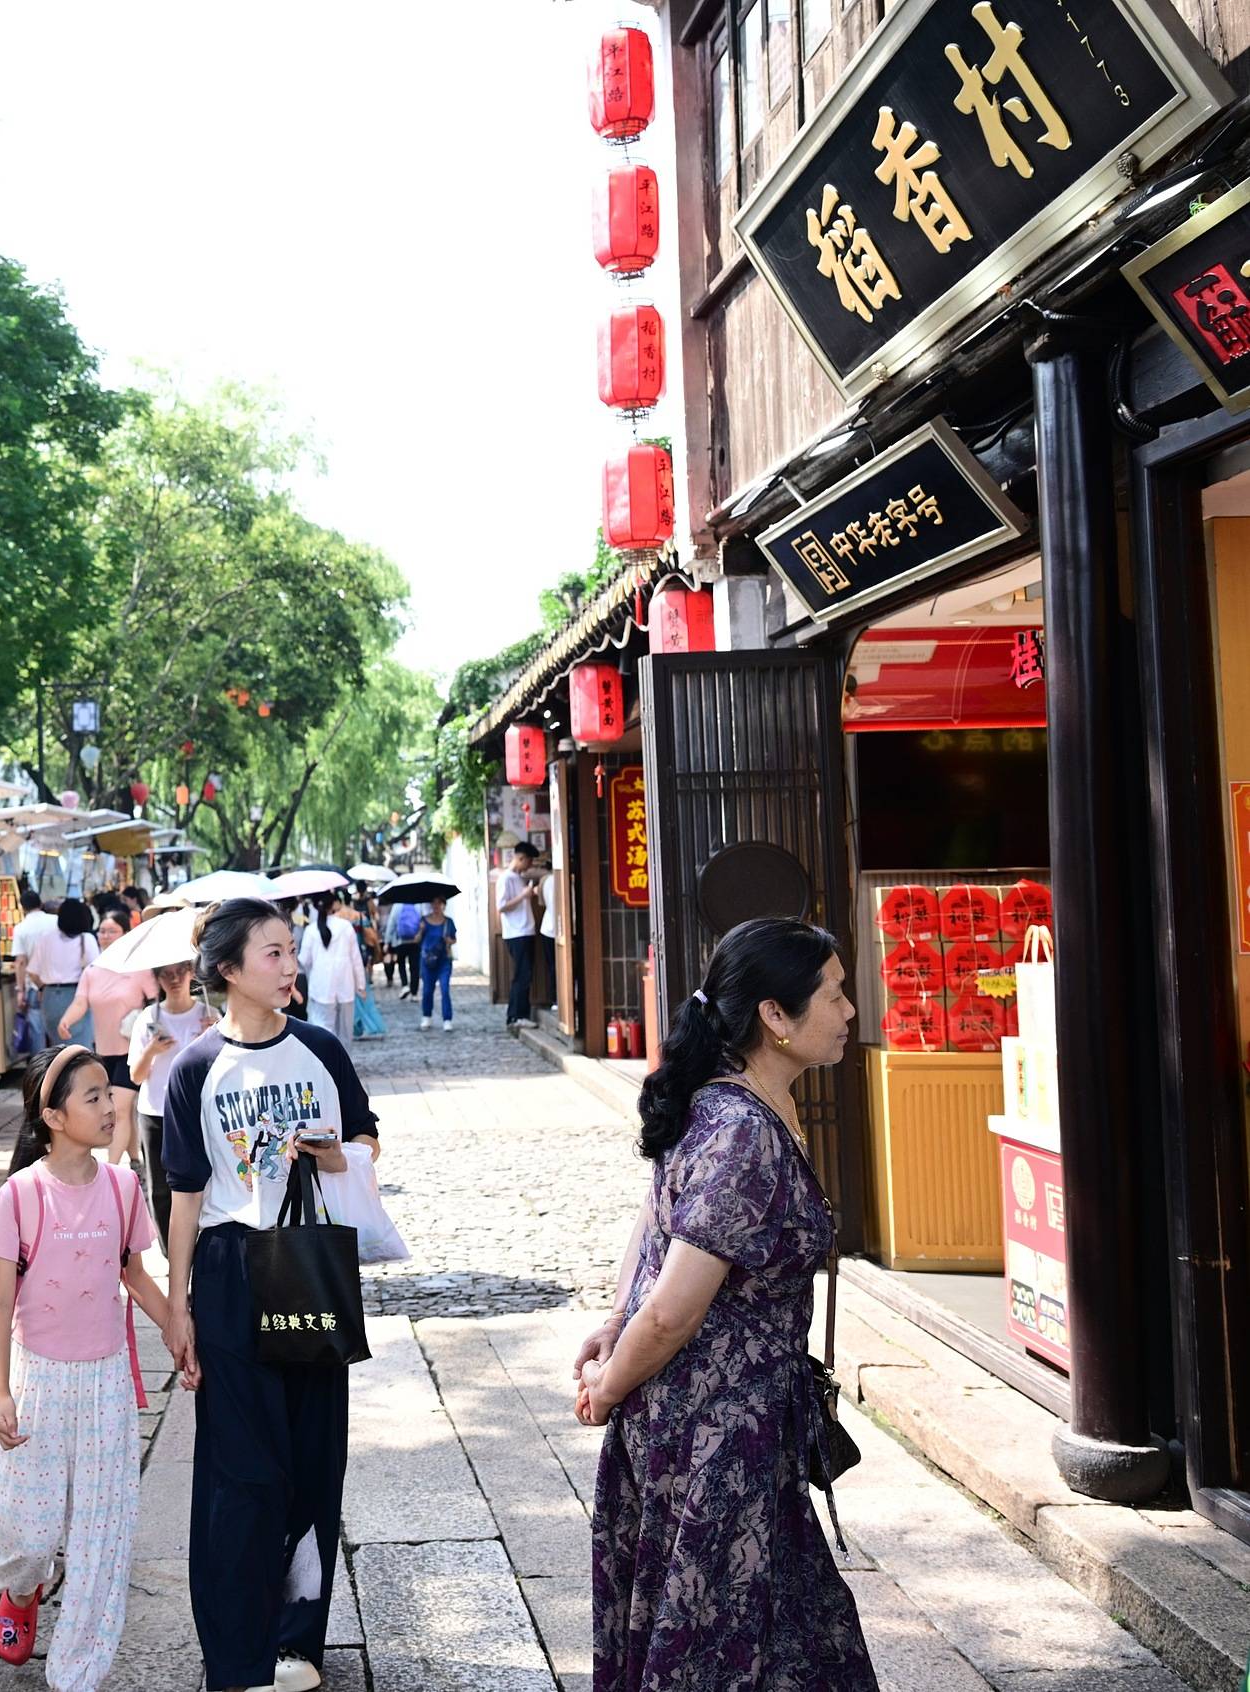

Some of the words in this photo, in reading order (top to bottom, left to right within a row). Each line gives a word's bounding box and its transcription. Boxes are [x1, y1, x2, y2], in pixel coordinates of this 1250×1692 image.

[1066, 12, 1130, 107] 1773
[805, 1, 1073, 324] 稻香村
[829, 484, 943, 566] 中华老字号
[215, 1082, 321, 1134] SNOWBALL
[272, 1312, 337, 1331] 经典文苑
